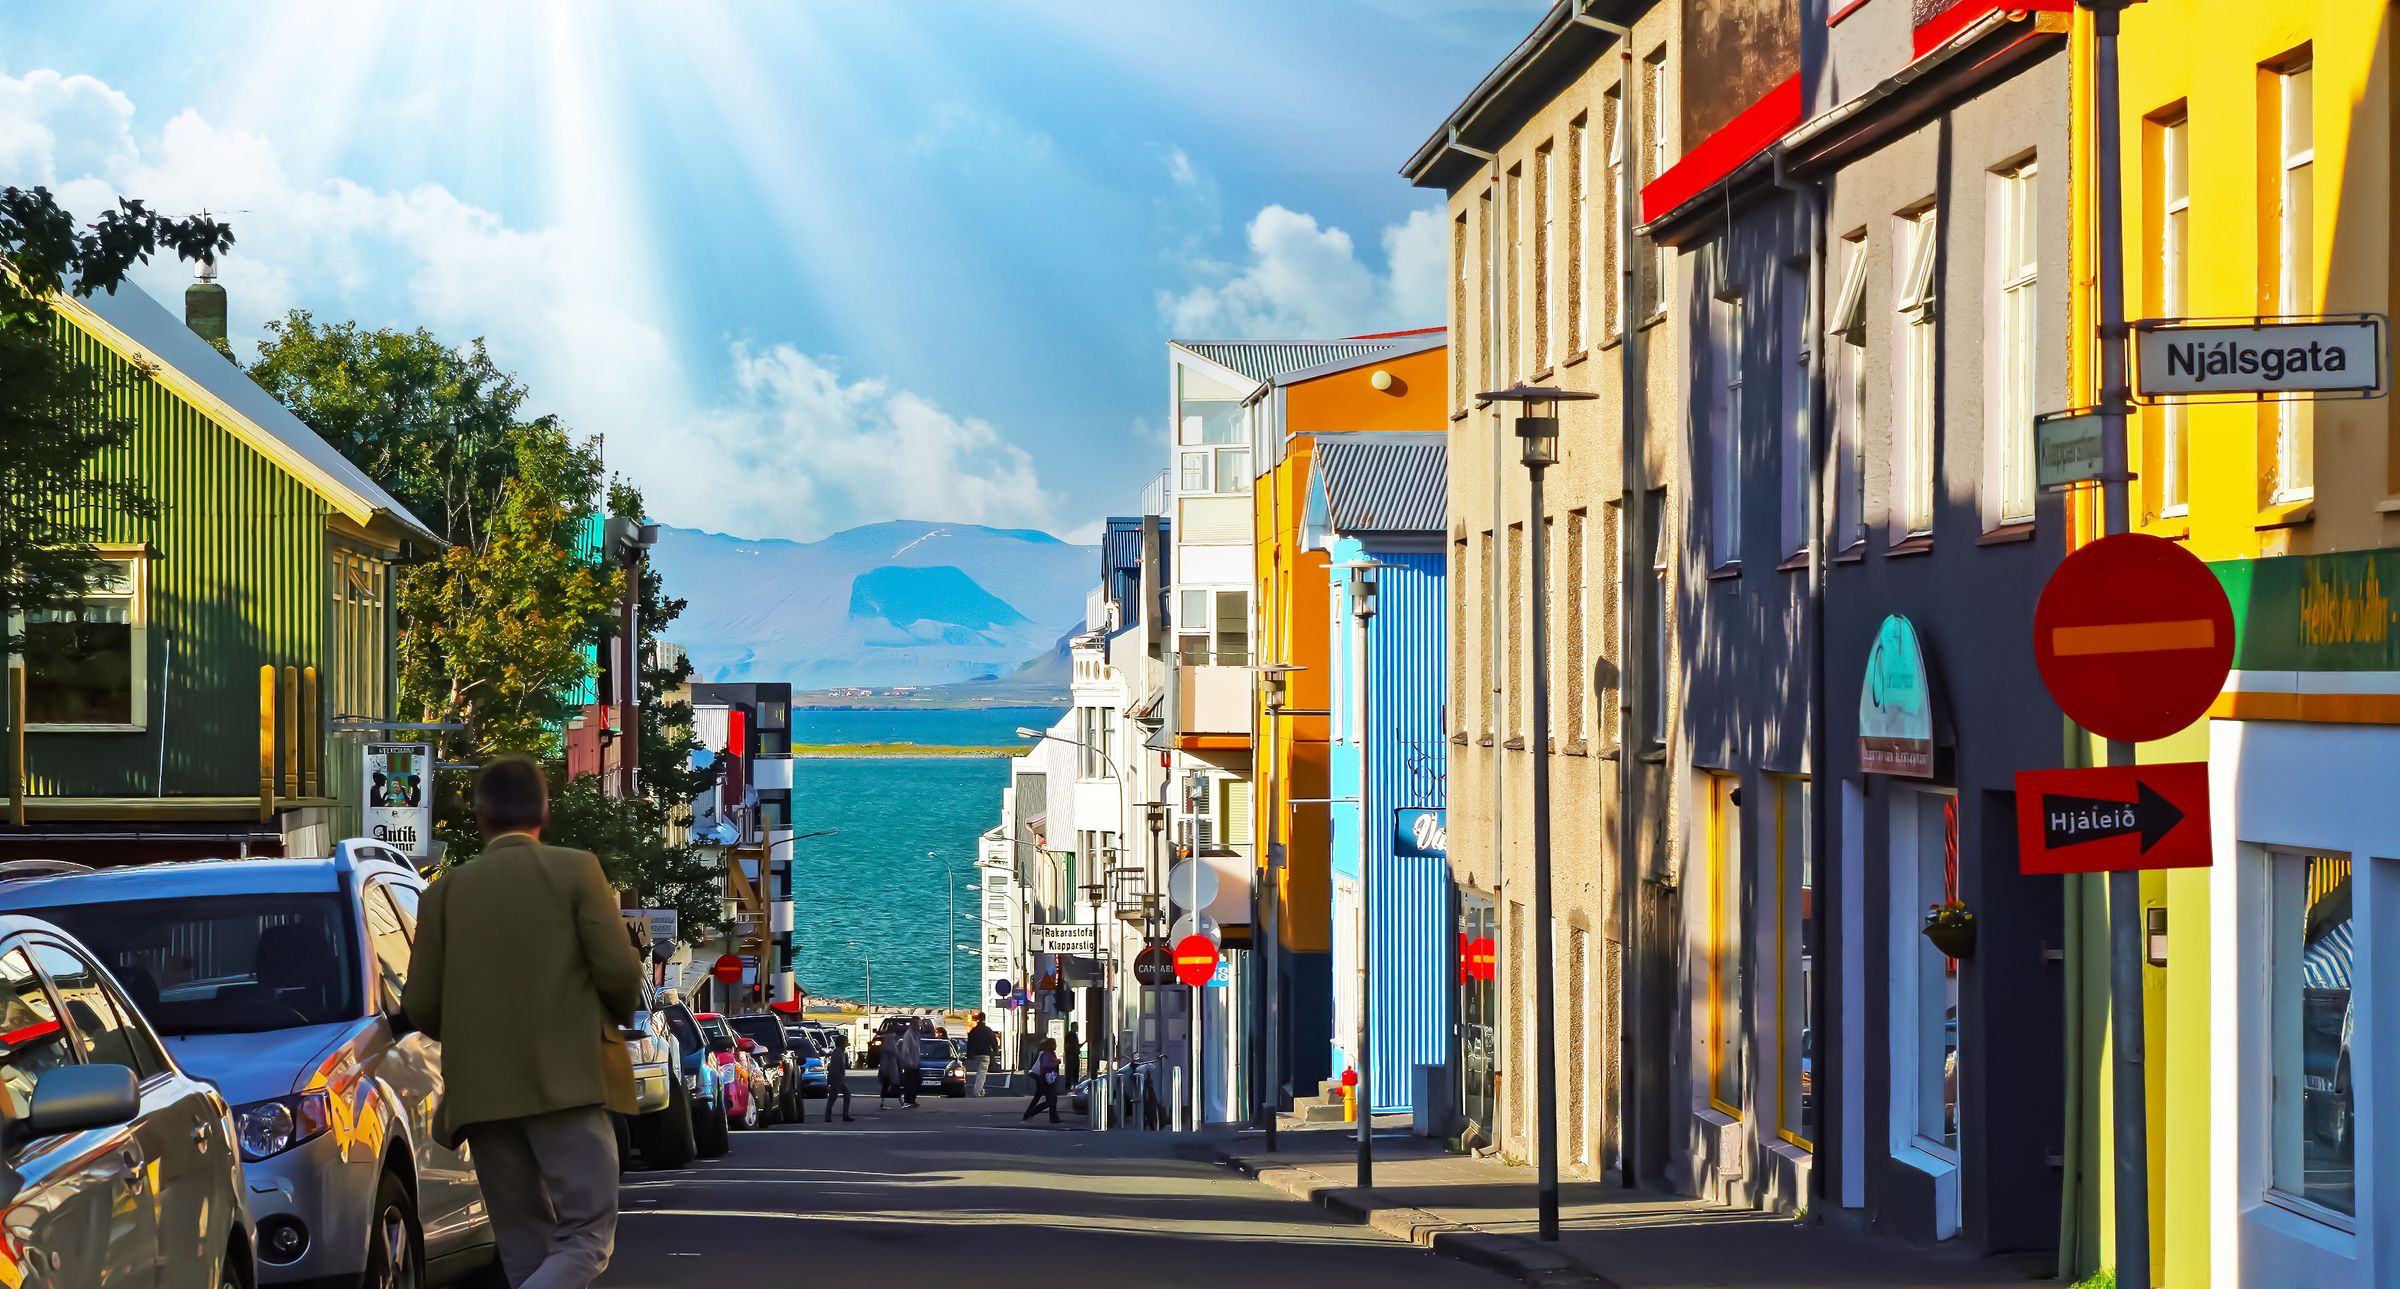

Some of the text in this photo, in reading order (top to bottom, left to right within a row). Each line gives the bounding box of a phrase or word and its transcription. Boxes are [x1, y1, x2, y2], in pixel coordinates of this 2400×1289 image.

[2167, 340, 2346, 382] Njálsgata
[2051, 804, 2136, 834] Hjáleið
[373, 824, 416, 842] Antik
[1045, 927, 1095, 938] Rakarastofa
[1138, 964, 1174, 973] CAMARI
